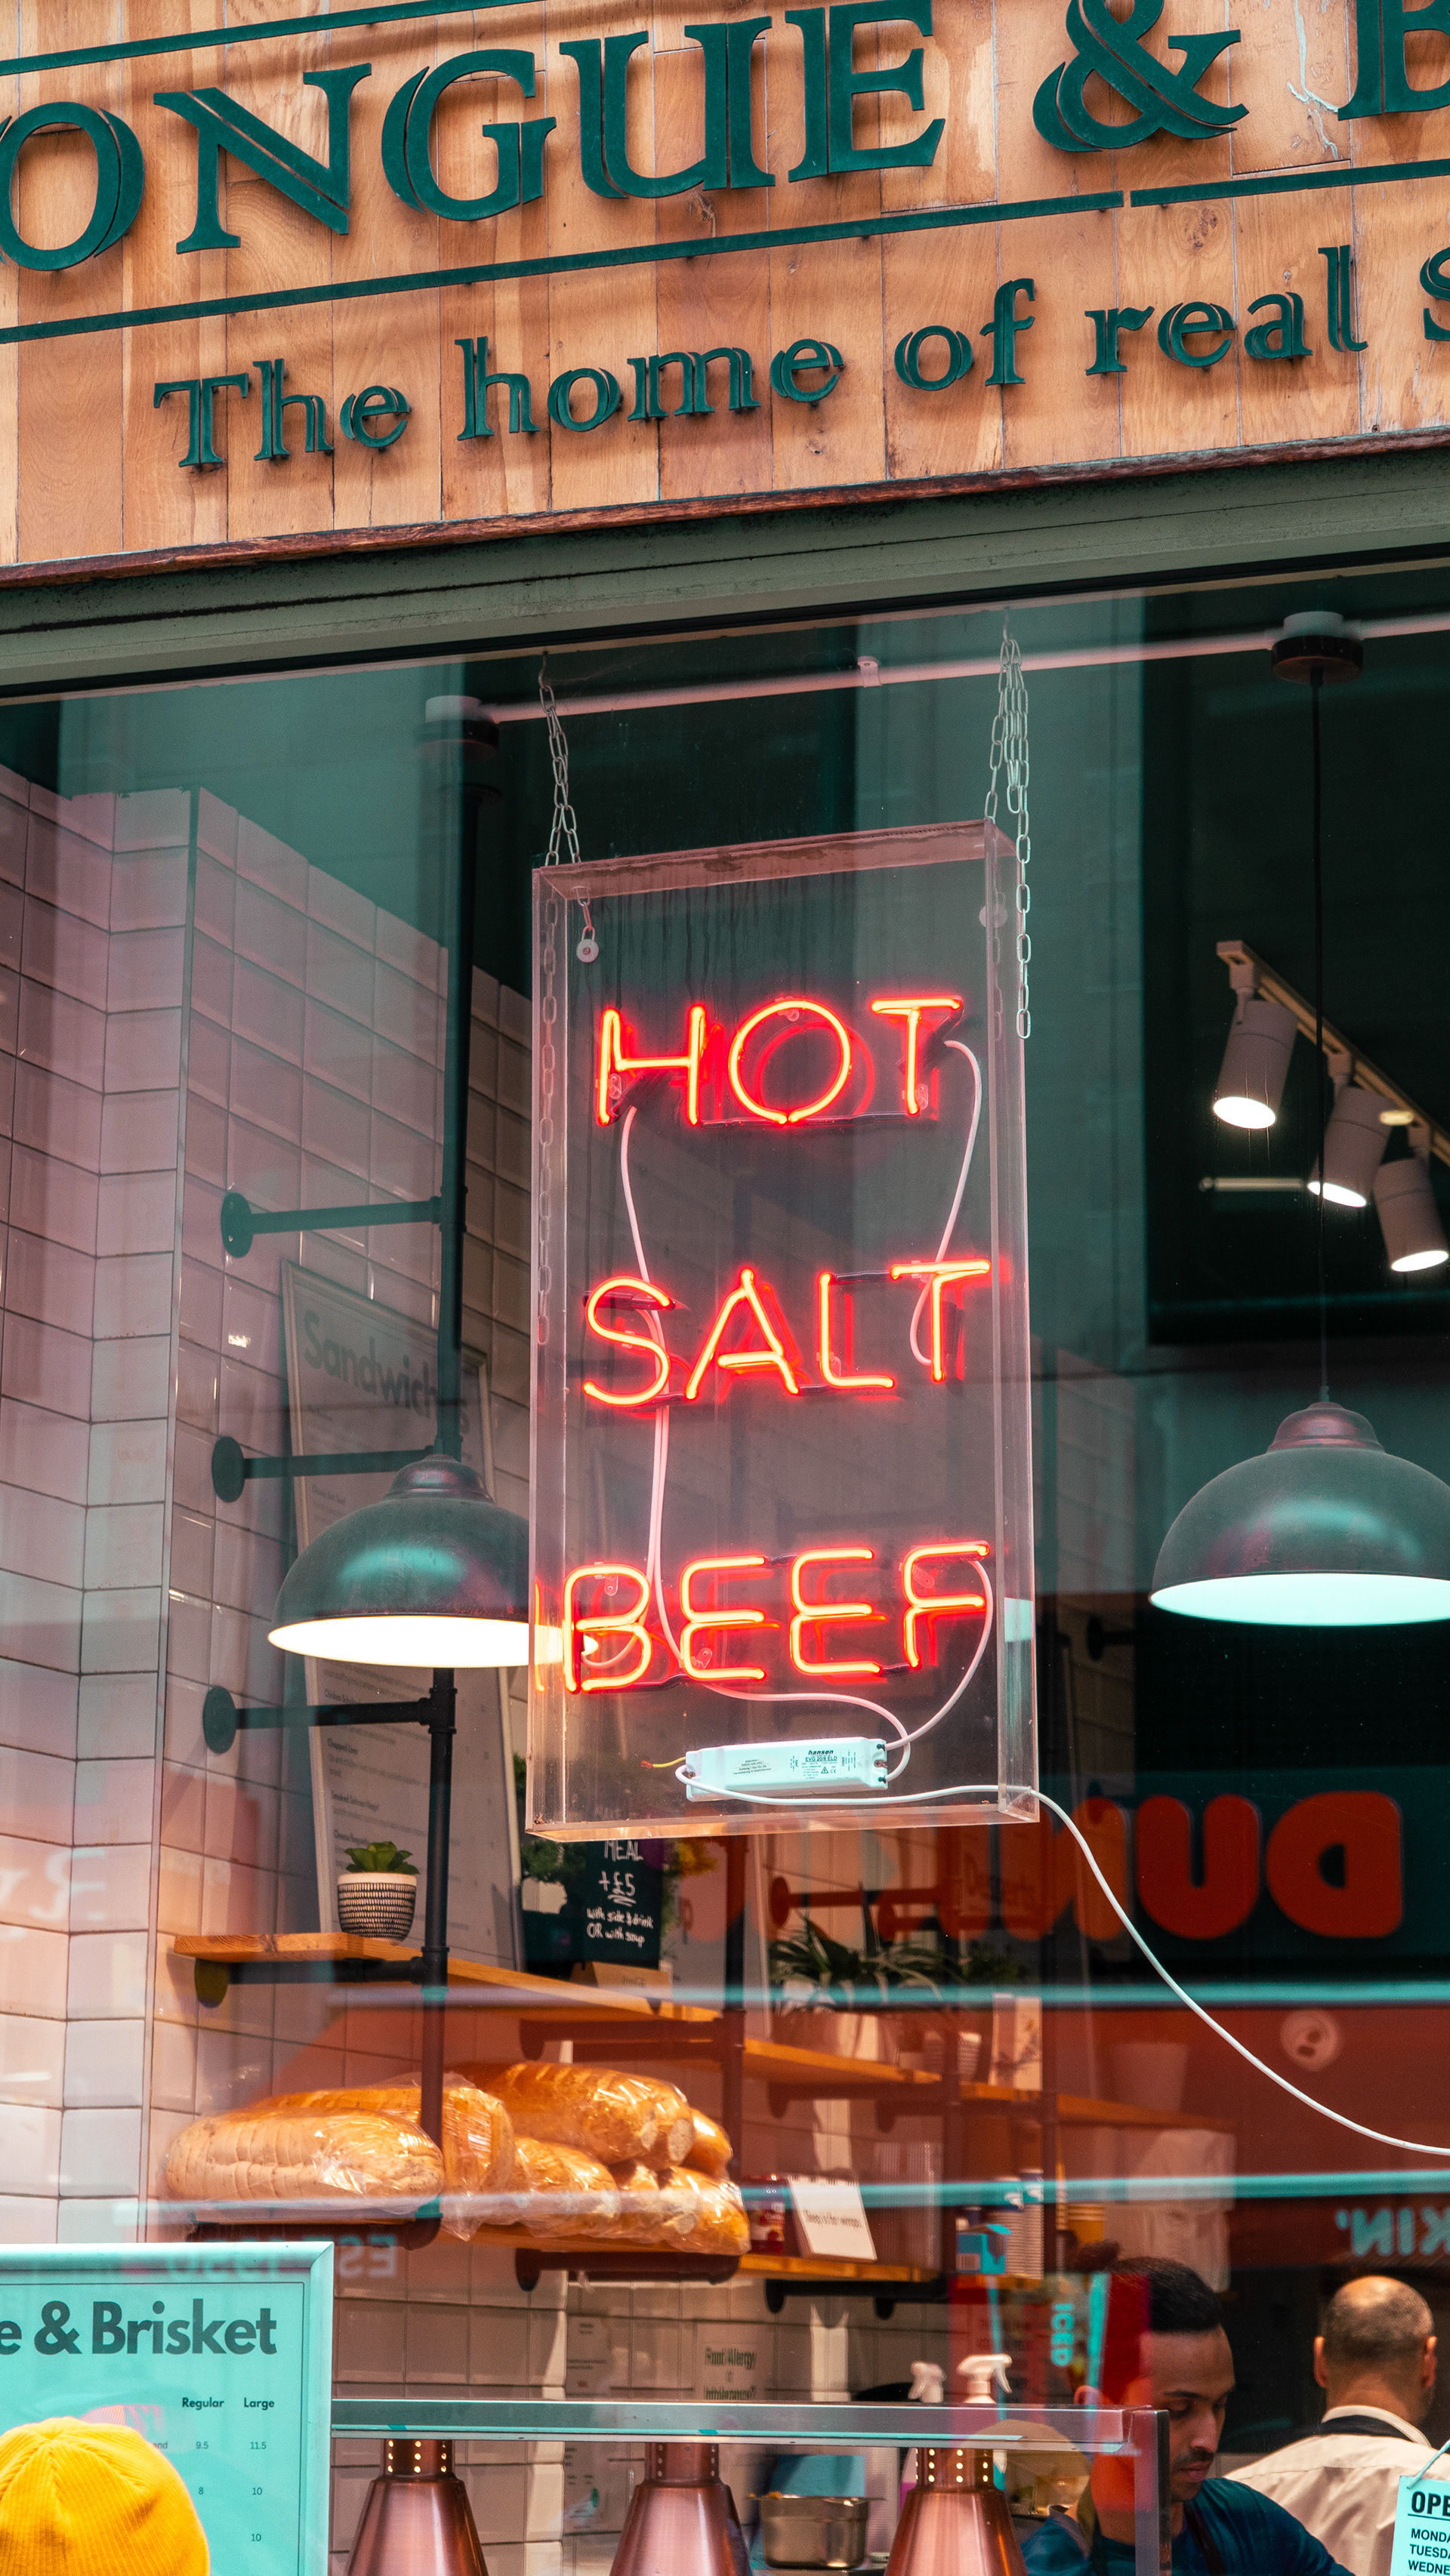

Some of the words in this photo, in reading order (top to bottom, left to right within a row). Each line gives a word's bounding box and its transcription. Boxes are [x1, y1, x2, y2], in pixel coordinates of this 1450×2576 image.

[0, 0, 946, 271] ONGUE
[1032, 0, 1248, 151] &
[153, 358, 411, 468] The
[455, 336, 844, 442] home
[894, 278, 1035, 392] of
[1085, 245, 1368, 376] real
[597, 996, 963, 1126] HOT
[582, 1259, 991, 1406] SALT
[304, 1310, 470, 1434] Sandwichs
[563, 1540, 990, 1693] BEEF
[604, 1840, 643, 1862] MEAL
[599, 1871, 635, 1896] +£5
[587, 1906, 605, 1920] with
[607, 1910, 625, 1923] side
[633, 1913, 653, 1928] drink
[587, 1922, 603, 1938] OR
[605, 1926, 624, 1940] with
[625, 1931, 645, 1947] soup
[34, 2300, 82, 2355] &
[92, 2298, 278, 2355] Brisket
[727, 2348, 755, 2370] Allergy
[182, 2397, 224, 2410] Regular
[244, 2397, 275, 2410] Large
[196, 2442, 209, 2450] 9.5
[250, 2442, 267, 2450] 11.5
[199, 2487, 204, 2495] 8
[252, 2487, 263, 2496] 10
[1411, 2491, 1450, 2516] OPE
[251, 2533, 262, 2542] 10
[1408, 2560, 1450, 2575] WEDNE
